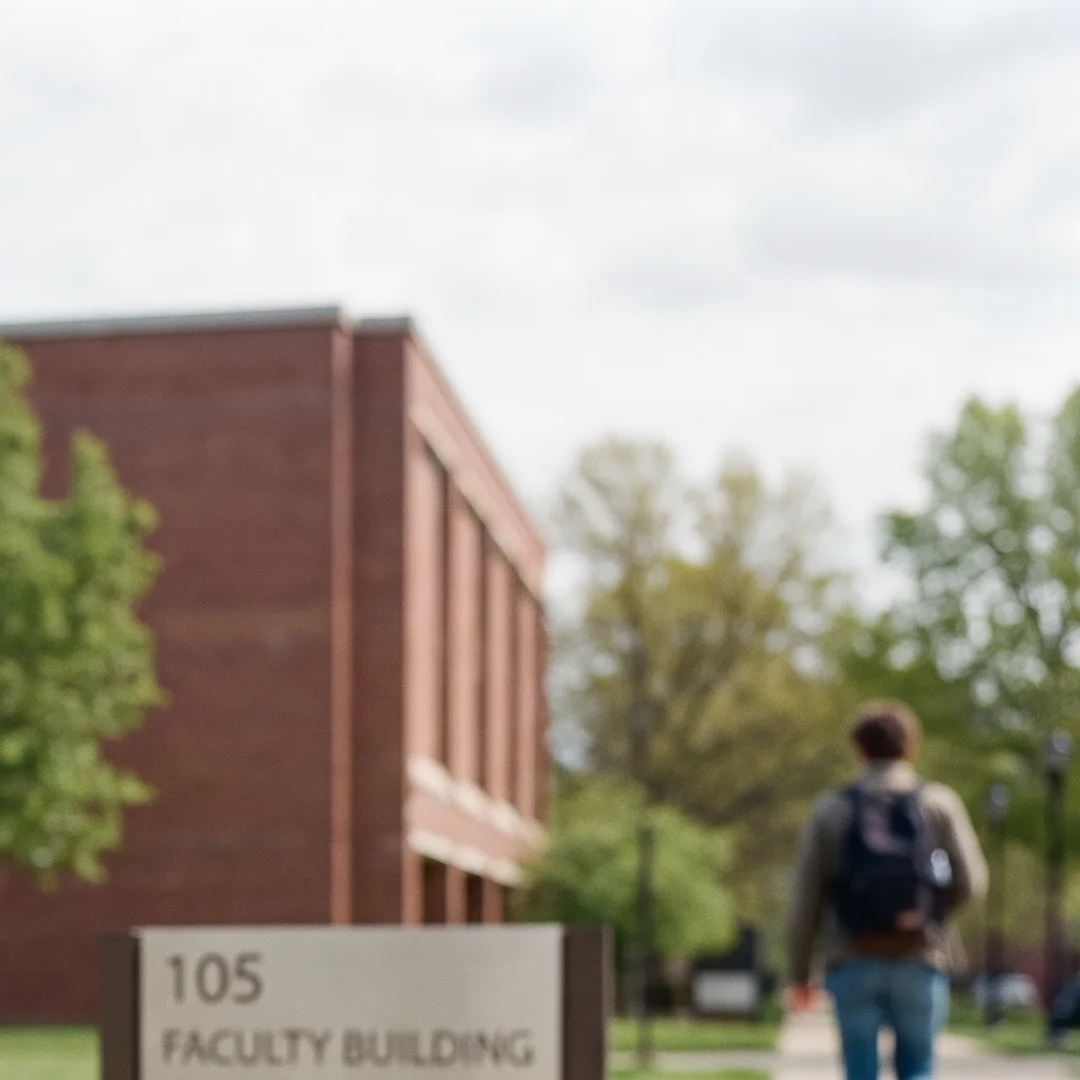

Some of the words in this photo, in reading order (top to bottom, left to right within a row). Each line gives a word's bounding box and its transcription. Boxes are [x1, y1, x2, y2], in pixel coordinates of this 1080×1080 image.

[167, 952, 263, 1004] 105
[161, 1029, 333, 1067] FACULTY
[341, 1028, 535, 1068] BUILDING
